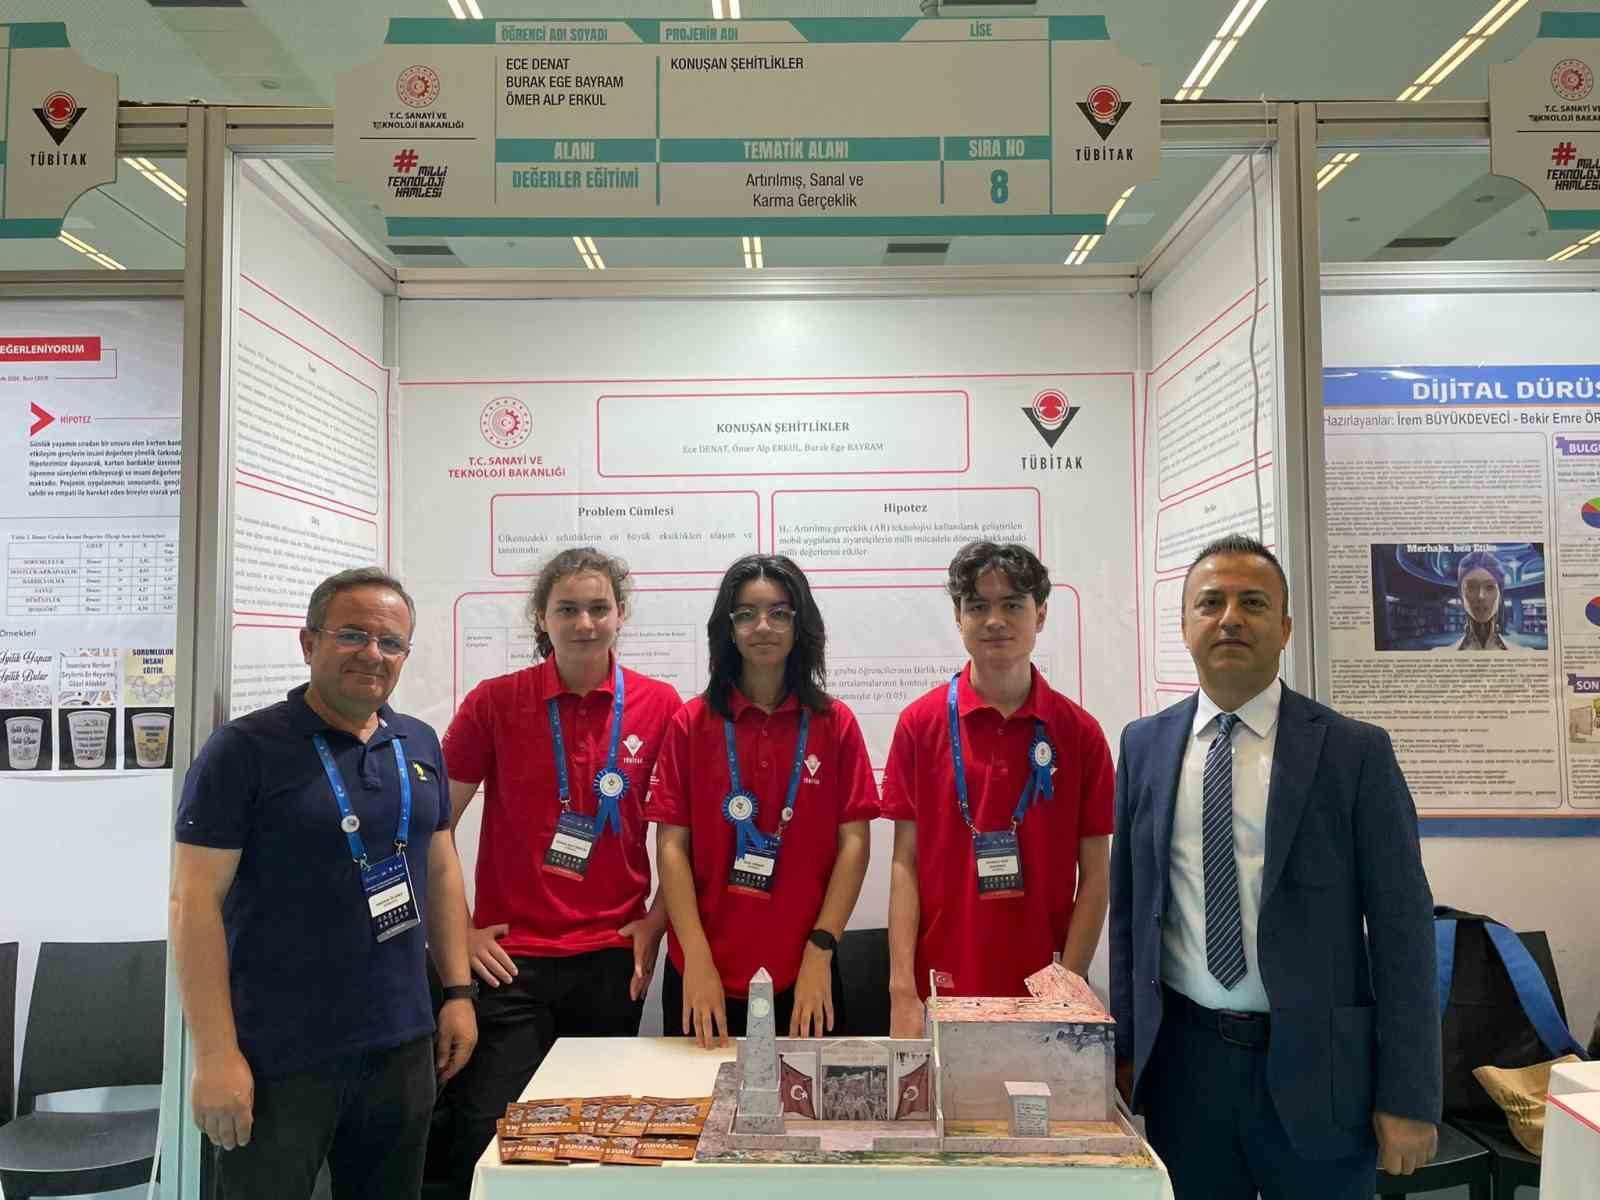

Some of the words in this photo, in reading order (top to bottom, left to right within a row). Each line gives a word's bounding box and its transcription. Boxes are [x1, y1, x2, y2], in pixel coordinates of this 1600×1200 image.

[501, 26, 546, 41] ÖĞRENCİ
[549, 28, 567, 41] ADI
[569, 28, 608, 41] SOYADI
[665, 26, 717, 41] PROJENİN
[720, 27, 738, 40] ADI
[970, 22, 992, 37] LİSE
[506, 58, 529, 70] ECE
[531, 58, 570, 70] DENAT
[670, 58, 728, 72] KONUŞAN
[731, 55, 804, 71] ŞEHİTLİKLER
[505, 76, 546, 88] BURAK
[548, 76, 572, 88] EGE
[575, 76, 624, 88] BAYRAM
[505, 92, 540, 106] ÖMER
[543, 94, 566, 106] ALP
[569, 94, 607, 106] ERKUL
[389, 112, 402, 120] T.C.
[405, 111, 434, 120] SANAYİ
[1545, 105, 1558, 113] T.C.
[1560, 104, 1591, 113] SANAYİ
[420, 120, 464, 129] BAKANLIĞI
[554, 142, 595, 160] ALANI
[743, 137, 804, 159] TEMATİK
[808, 141, 849, 159] ALANI
[969, 139, 1001, 158] SIRA
[1005, 139, 1025, 157] NO
[1075, 146, 1134, 162] TÜBİTAK
[30, 151, 87, 166] TÜBİTAK
[387, 176, 446, 188] TEKNOLOJİ
[512, 168, 582, 189] DEĞERLER
[587, 167, 639, 189] EĞİTİMİ
[746, 173, 807, 188] Artırılmış,
[810, 173, 845, 187] Sanal
[848, 176, 864, 187] ve
[395, 187, 443, 199] HAMLESİ
[990, 169, 1009, 204] 8
[752, 194, 795, 207] Karma
[797, 193, 857, 210] Gerçeklik
[1413, 378, 1509, 402] DİJİTAL
[60, 415, 92, 424] HİPOTEZ
[1397, 411, 1422, 425] İrem
[1426, 411, 1511, 424] BÜYÜKDEVECİ
[1520, 413, 1549, 424] Bekir
[1553, 413, 1581, 424] Emre
[717, 423, 772, 434] KONUŞAN
[774, 419, 850, 434] ŞEHİTLİKLER
[682, 445, 698, 454] Ece
[699, 444, 730, 454] DENAT,
[756, 444, 770, 454] Alp
[847, 442, 884, 451] BAYRAM
[1569, 443, 1600, 453] BULG
[469, 457, 486, 466] T.C.
[488, 455, 526, 465] SANAYİ
[529, 456, 543, 465] VE
[1021, 454, 1084, 470] TÜBİTAK
[448, 468, 506, 478] TEKNOLOJİ
[508, 466, 566, 477] BAKANLIĞI
[578, 505, 626, 517] Problem
[628, 505, 674, 516] Cümlesi
[883, 502, 929, 516] Hipotez
[1576, 680, 1600, 690] SON
